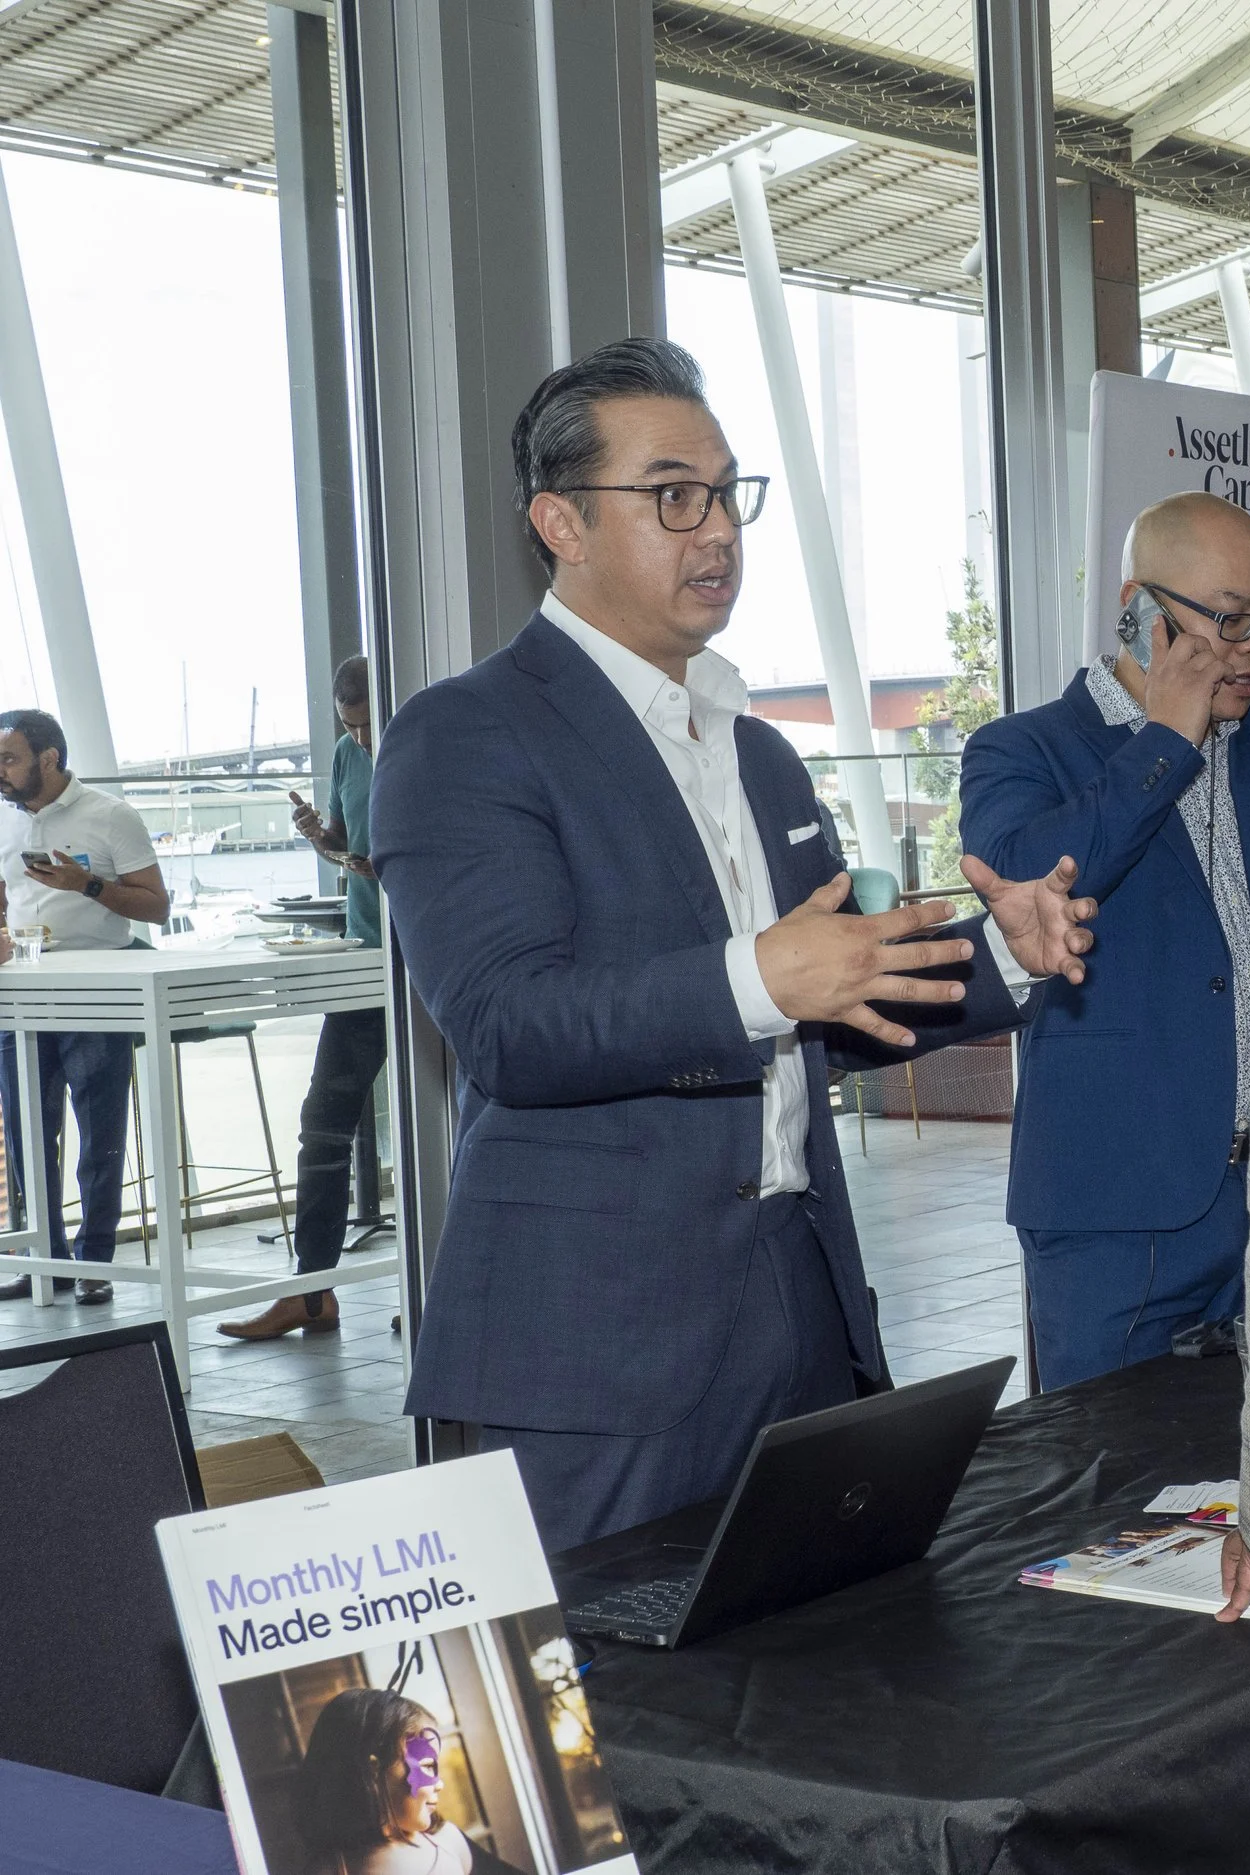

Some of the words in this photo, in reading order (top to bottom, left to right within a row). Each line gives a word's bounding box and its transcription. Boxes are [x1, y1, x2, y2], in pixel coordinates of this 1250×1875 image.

[206, 1553, 364, 1614] Monthly
[372, 1530, 457, 1577] LMI.
[218, 1608, 332, 1660] Made
[340, 1577, 476, 1632] simple.
